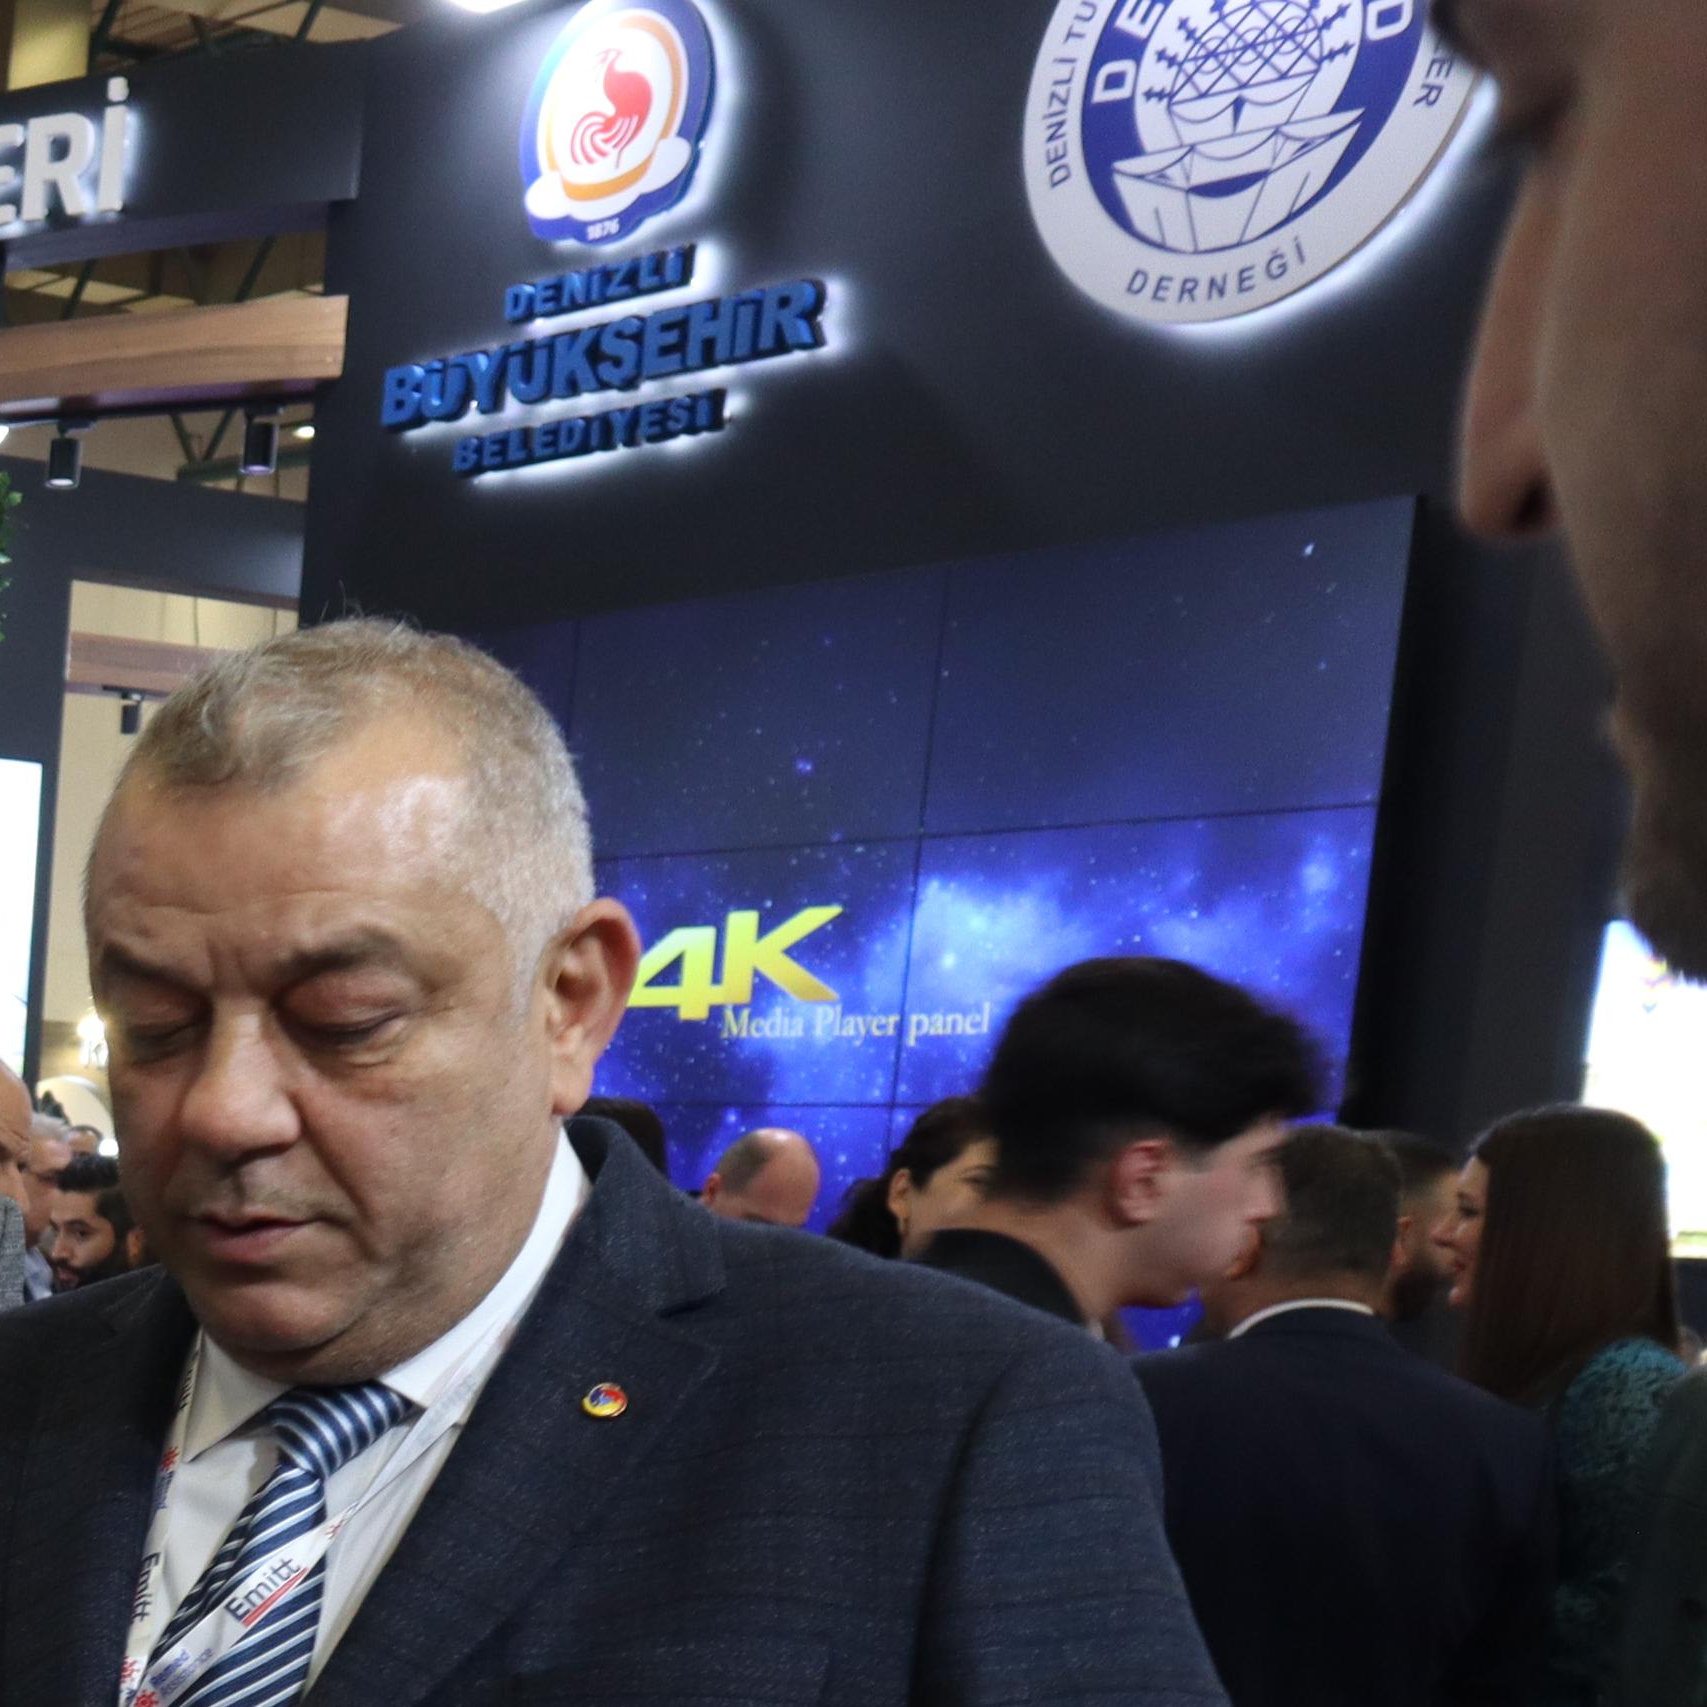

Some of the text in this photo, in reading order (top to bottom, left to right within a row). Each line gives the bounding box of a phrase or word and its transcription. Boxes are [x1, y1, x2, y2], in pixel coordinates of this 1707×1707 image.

[1126, 235, 1306, 304] DERNEĞİ
[626, 904, 844, 1020] 4K
[719, 1001, 990, 1047] Media Player panel
[224, 1557, 302, 1622] Emitt
